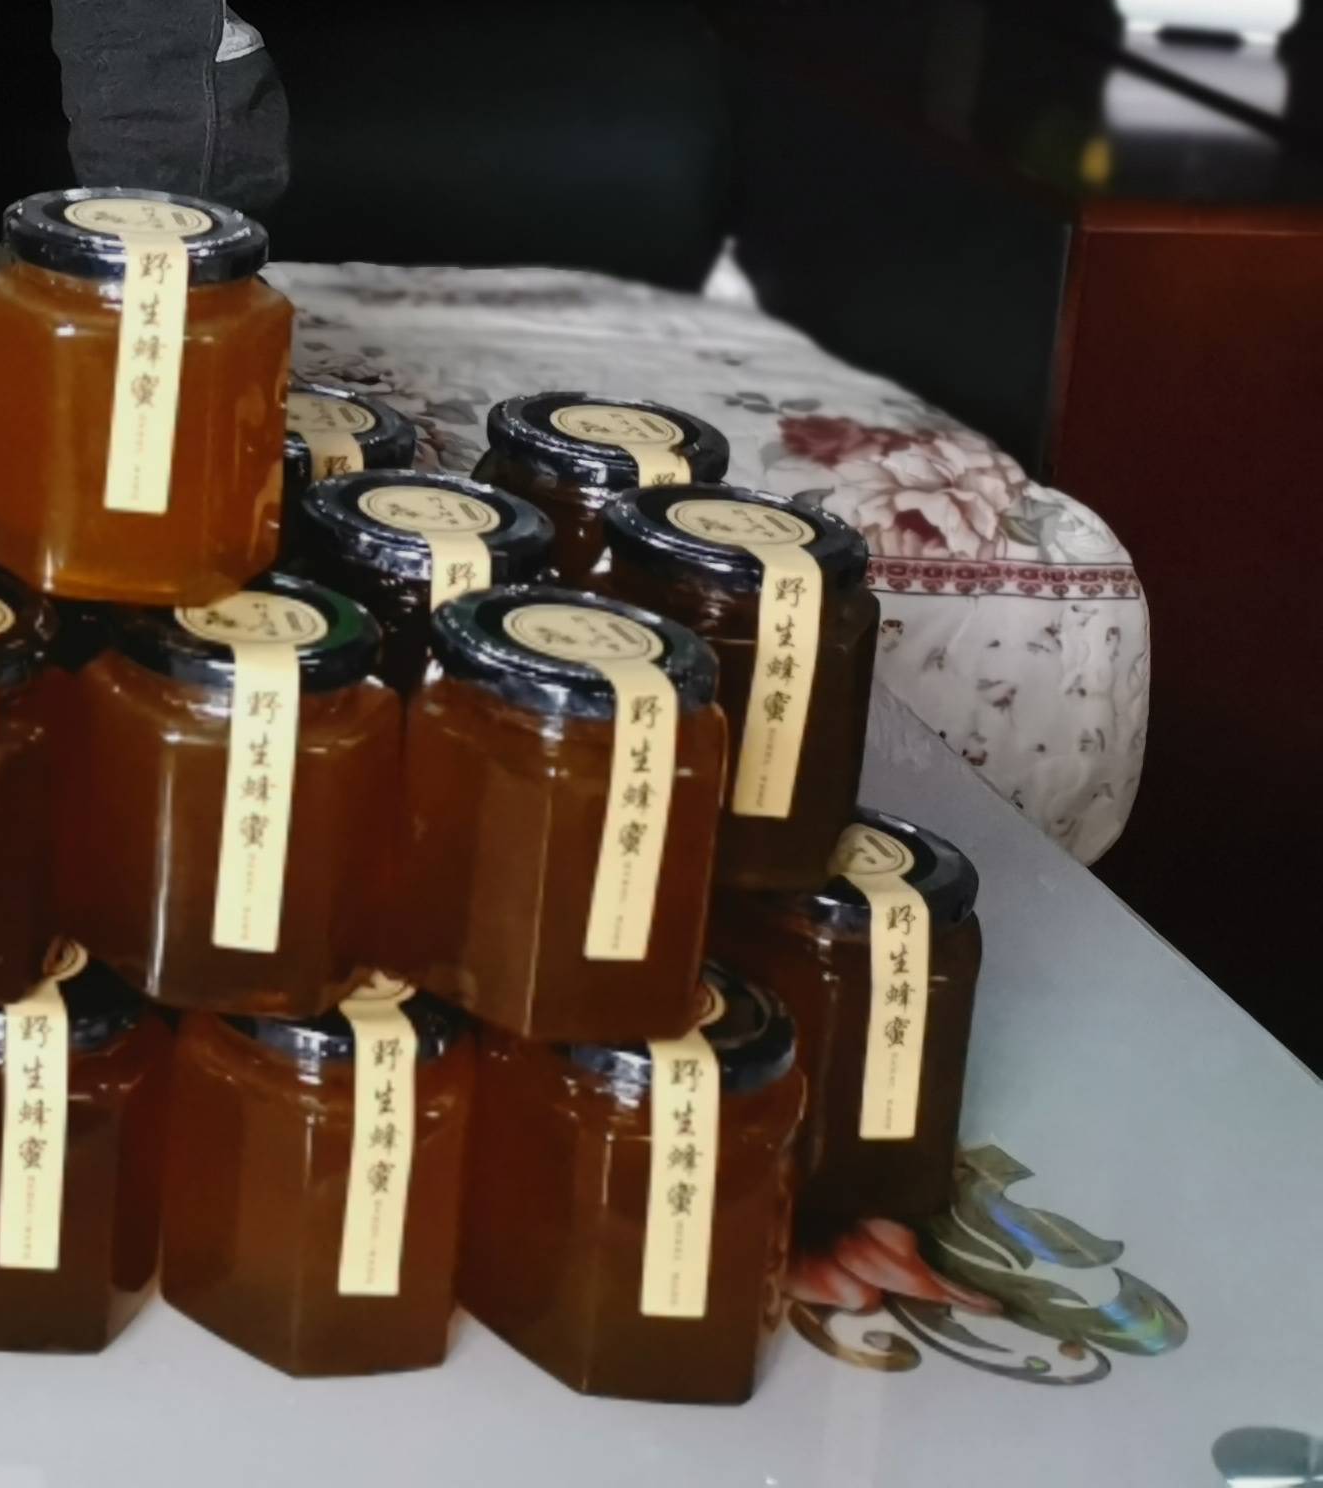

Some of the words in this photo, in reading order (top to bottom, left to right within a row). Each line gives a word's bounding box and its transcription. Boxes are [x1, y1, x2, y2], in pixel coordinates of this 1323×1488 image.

[131, 252, 172, 409] 野生蜂蜜
[762, 577, 805, 725] 野生蜂蜜
[239, 691, 282, 848] 野生蜂蜜
[618, 695, 664, 858] 野生蜂蜜
[885, 905, 916, 1049] 野生蜂蜜
[18, 1015, 52, 1171] 野生蜂蜜
[368, 1039, 404, 1197] 野生蜂蜜
[667, 1059, 703, 1217] 野生蜂蜜
